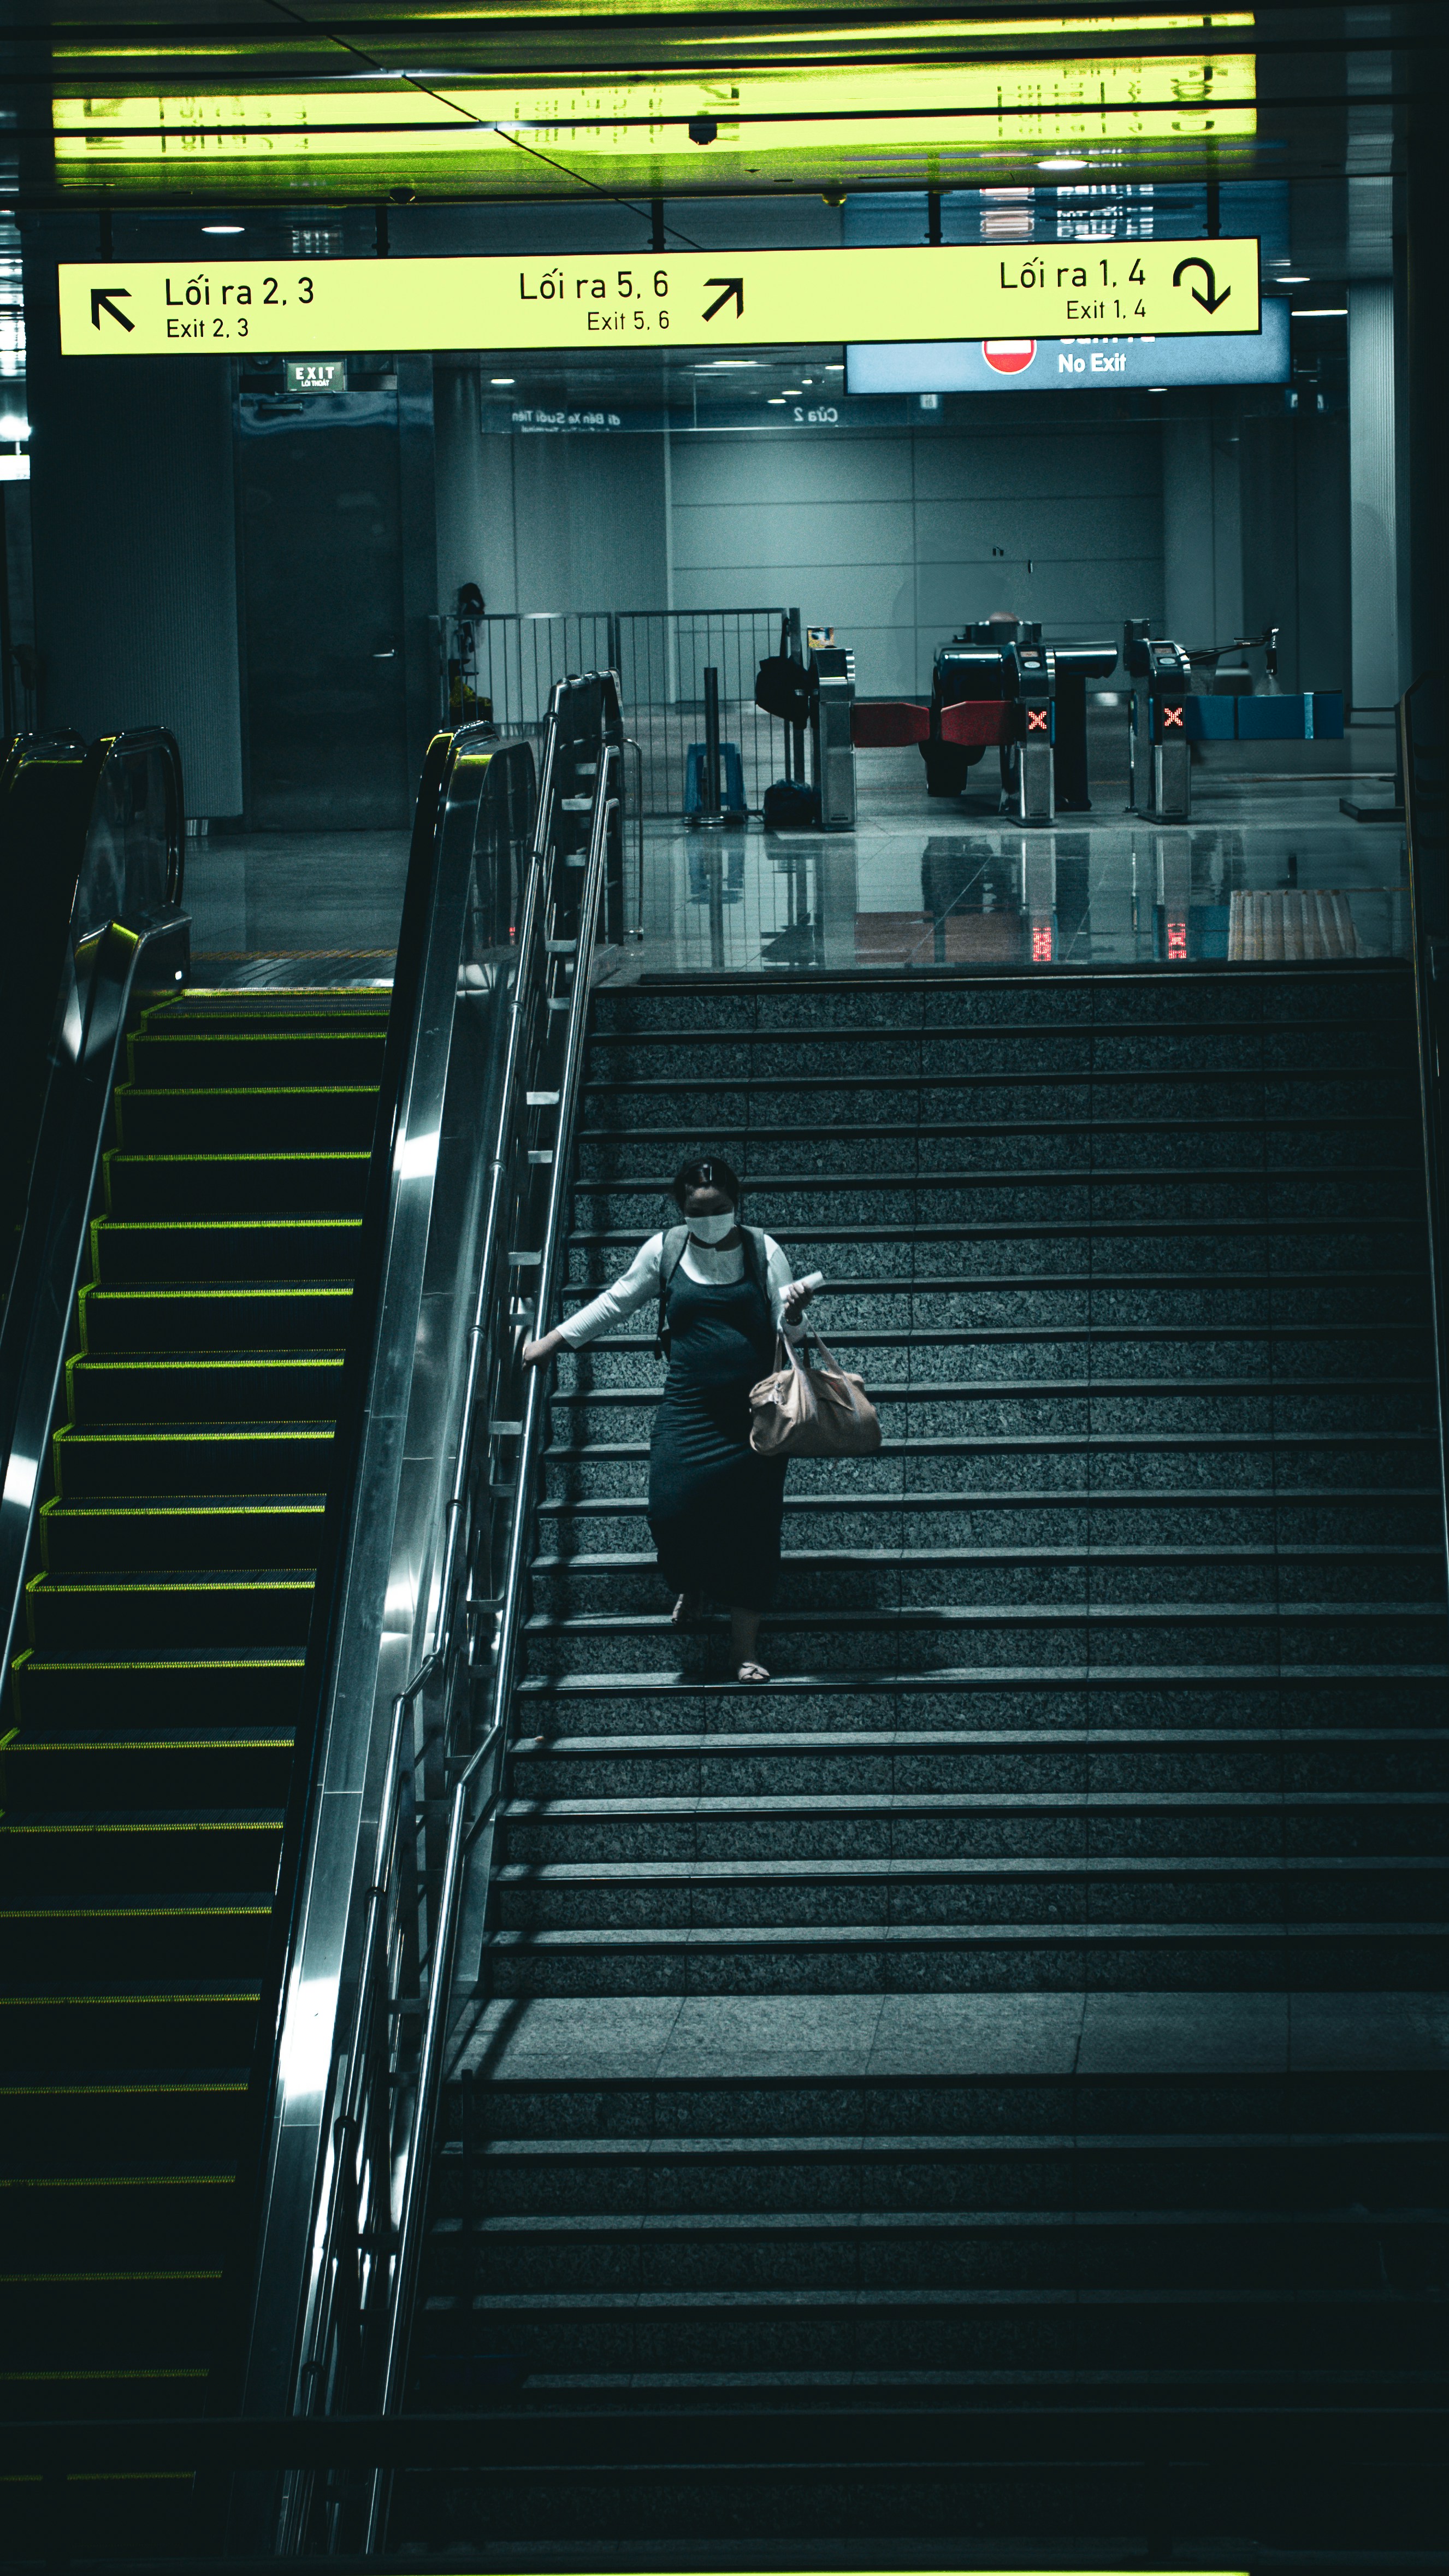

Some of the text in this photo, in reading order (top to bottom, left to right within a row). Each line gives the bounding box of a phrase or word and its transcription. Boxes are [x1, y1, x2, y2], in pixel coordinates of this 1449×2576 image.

[1001, 257, 1146, 288] Lối ra 1, 4
[165, 274, 314, 306] Lối ra 2, 3
[520, 268, 668, 299] Lối ra 5, 6
[588, 310, 669, 330] Exit 5, 6
[1067, 299, 1146, 320] Exit 1, 4
[167, 317, 249, 338] Exit 2, 3
[295, 366, 335, 380] EXIT
[1058, 352, 1127, 373] No Exit
